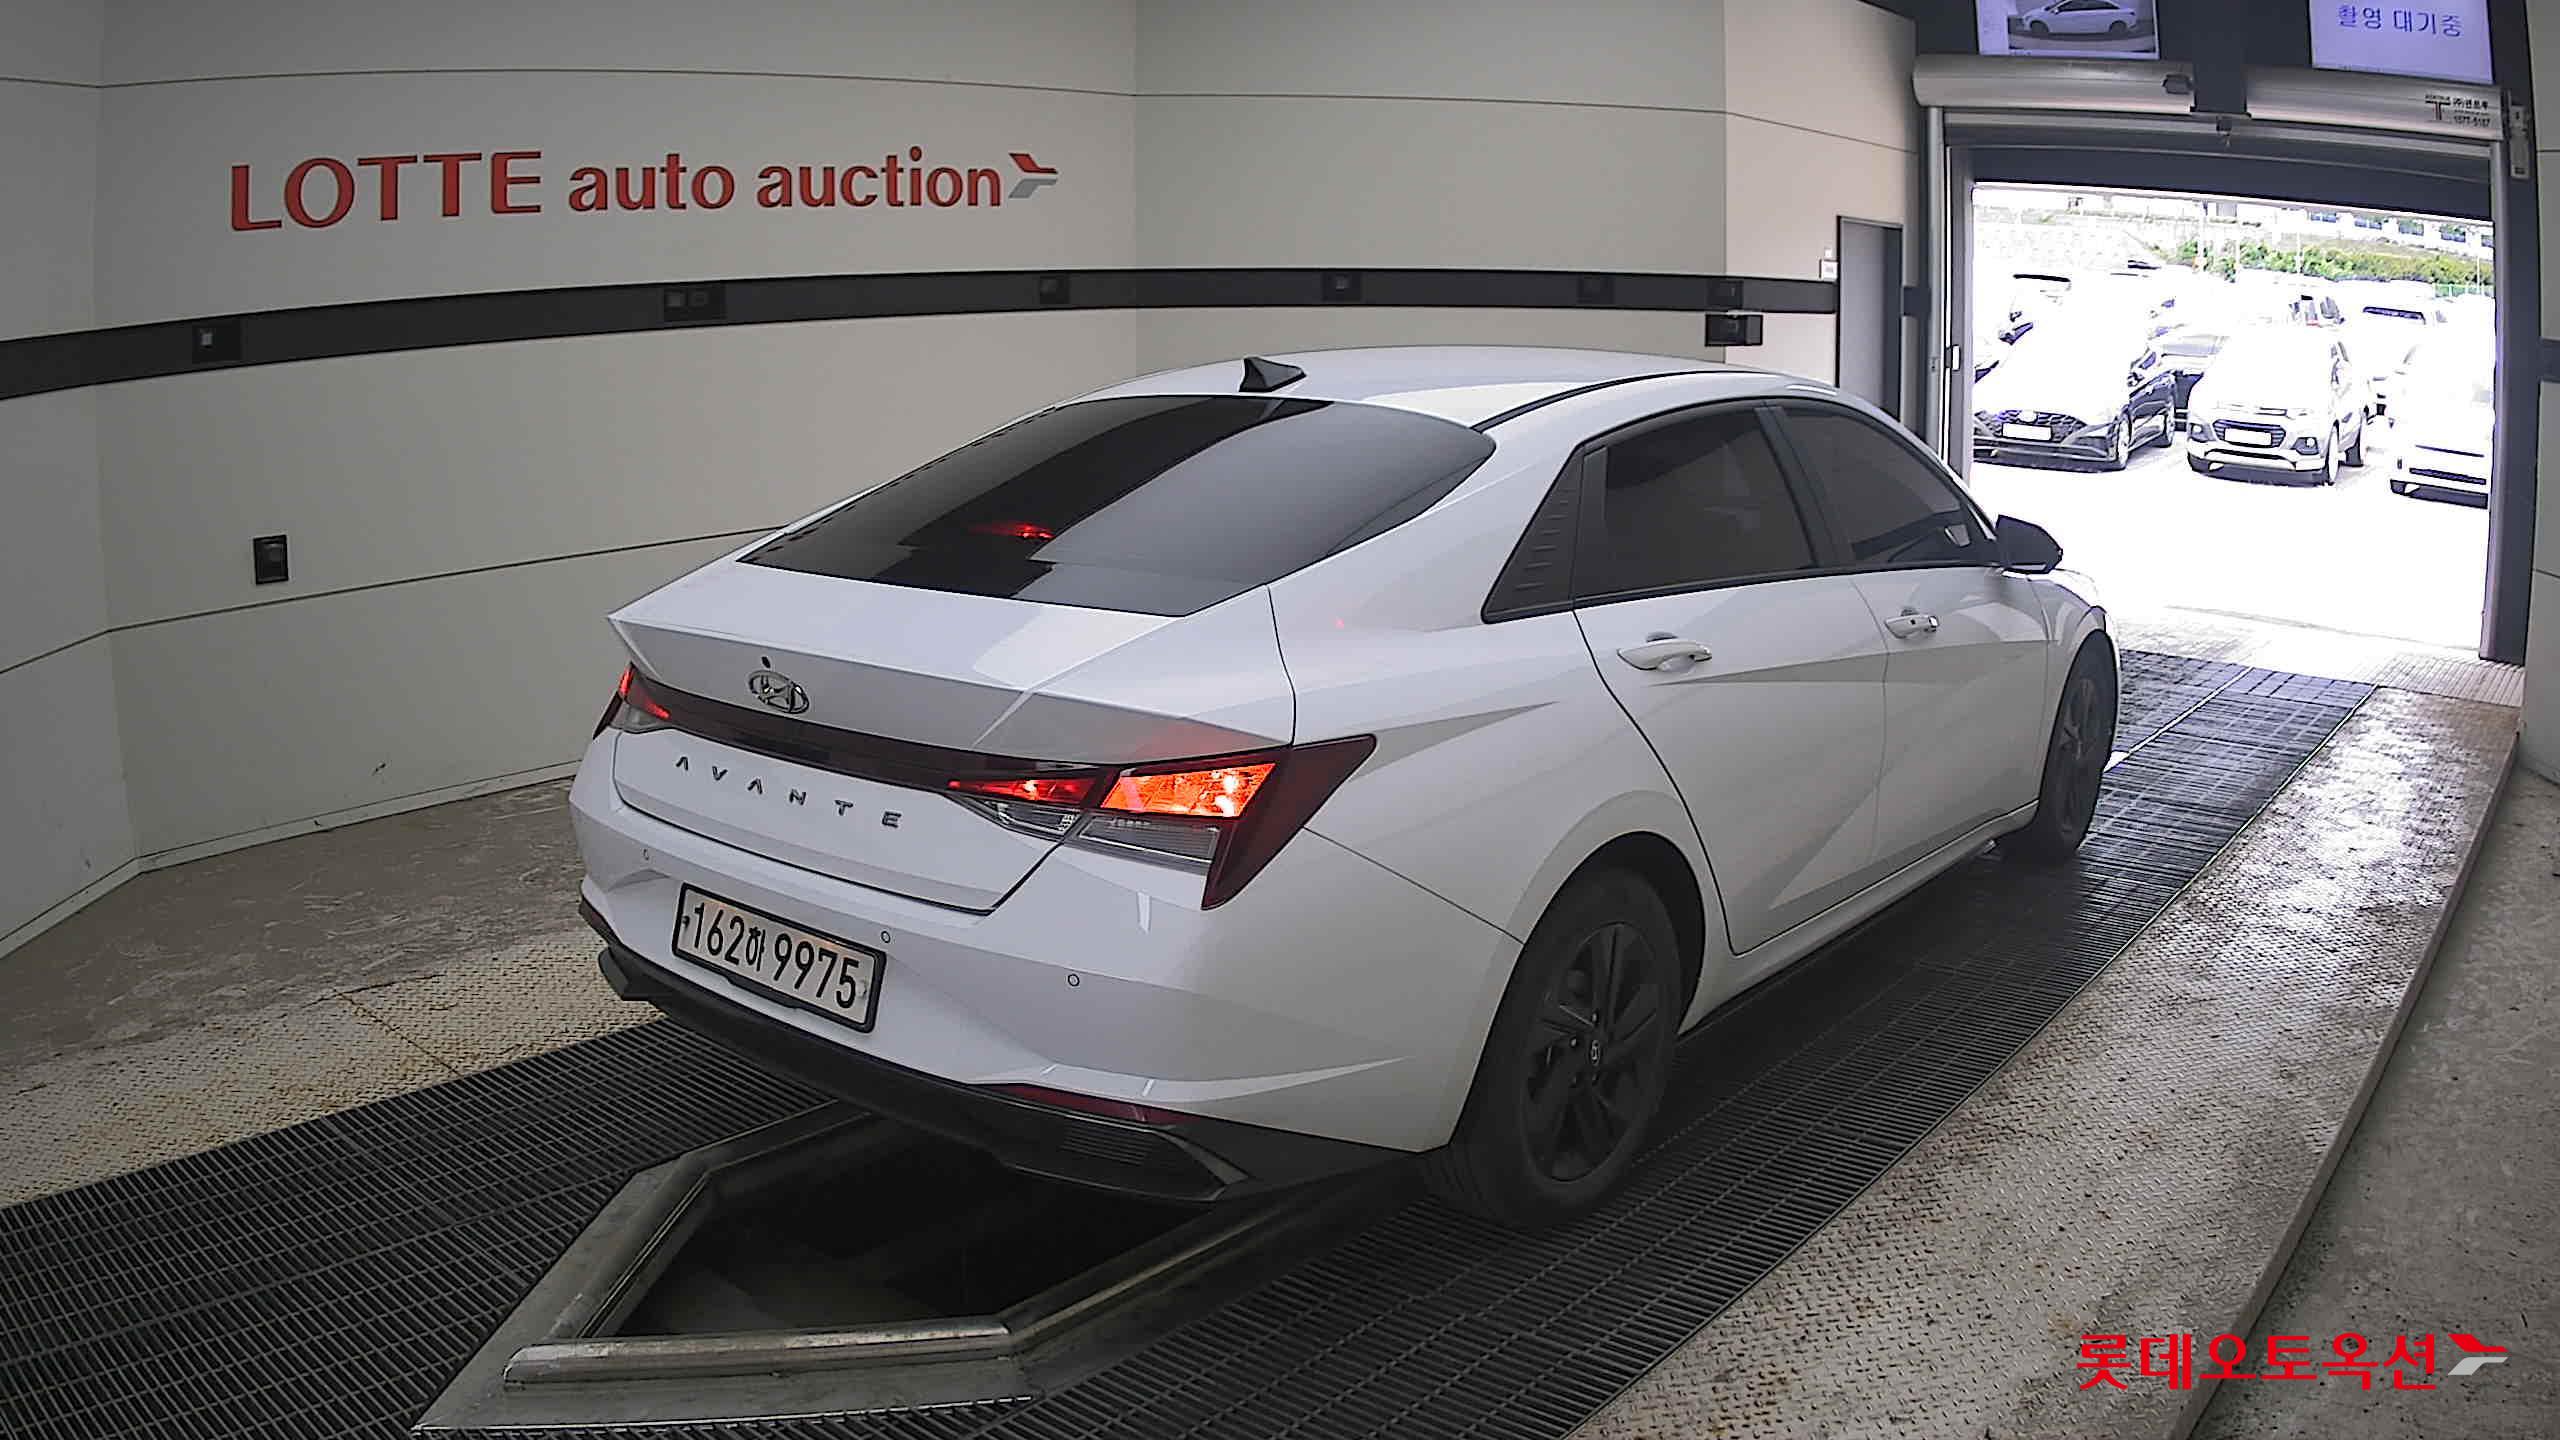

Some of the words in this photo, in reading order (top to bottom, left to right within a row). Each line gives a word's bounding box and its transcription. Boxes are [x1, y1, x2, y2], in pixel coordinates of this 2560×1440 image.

[2338, 4, 2383, 30] 촬영
[2392, 9, 2463, 38] 대기중
[231, 151, 541, 231] LOTTE
[567, 152, 736, 212] auto
[757, 146, 1002, 208] auction
[675, 756, 902, 829] AVANTE
